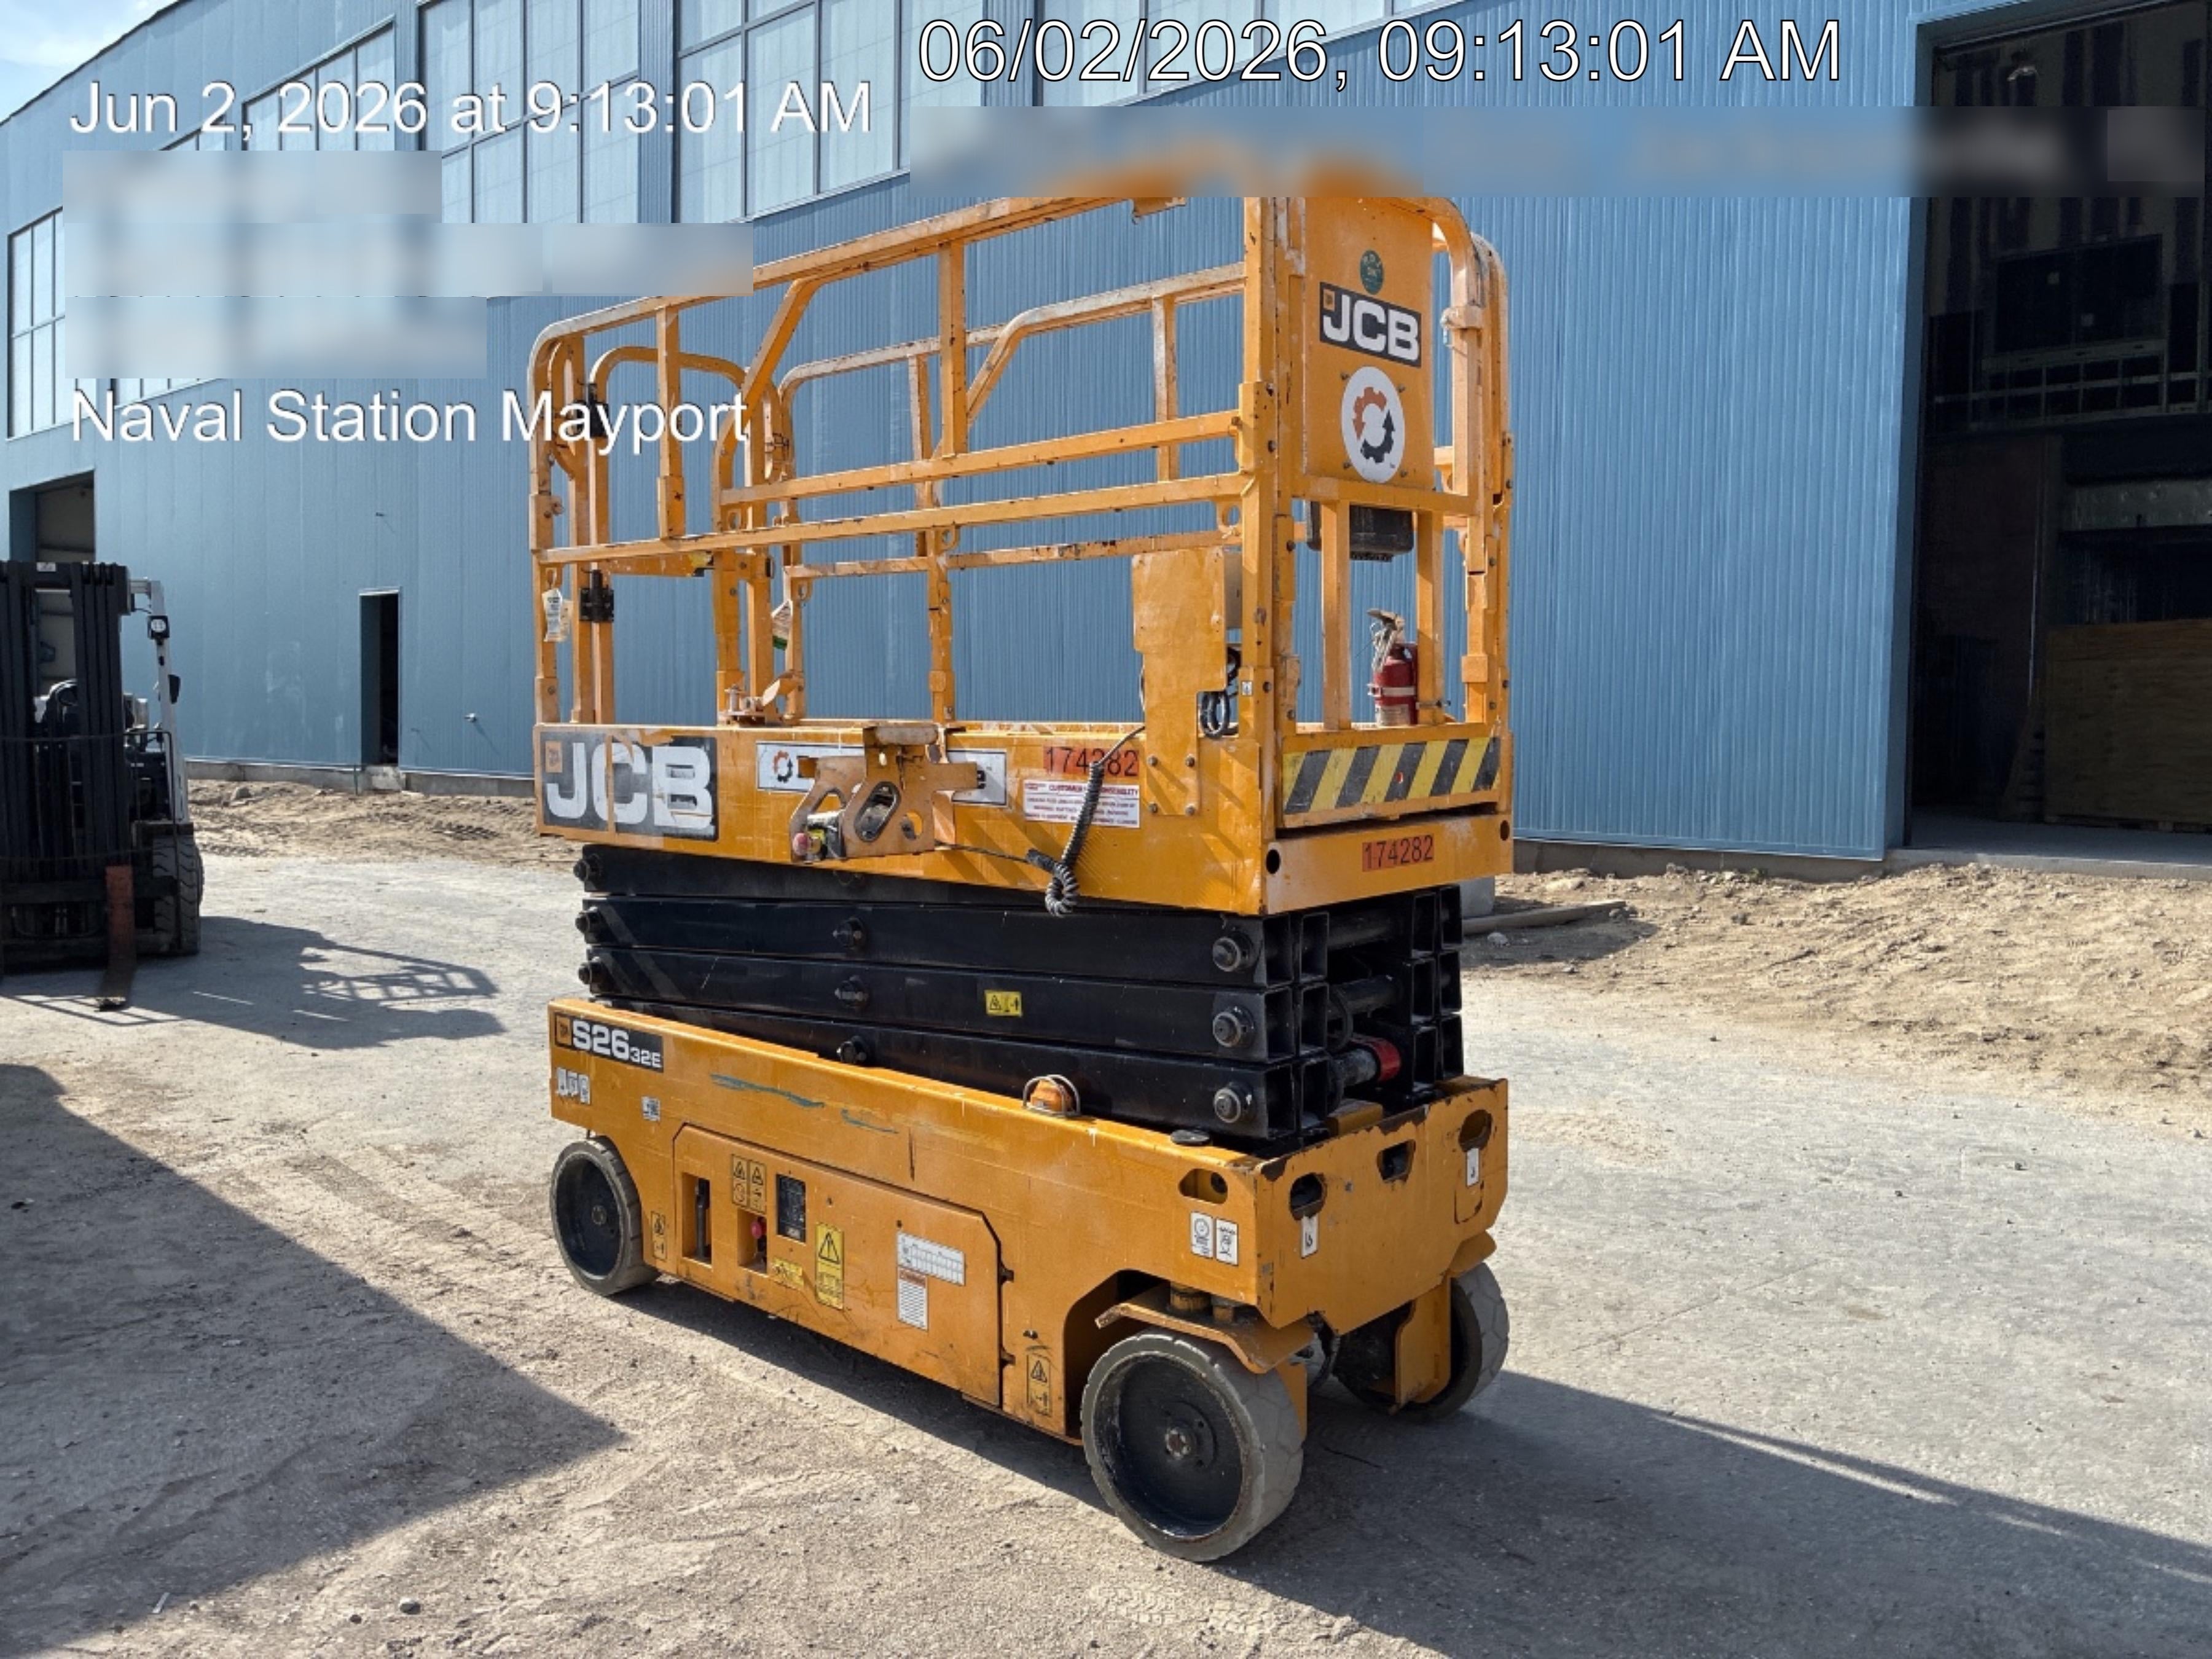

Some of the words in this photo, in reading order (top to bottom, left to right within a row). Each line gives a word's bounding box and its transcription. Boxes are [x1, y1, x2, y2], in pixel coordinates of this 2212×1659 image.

[1323, 292, 1420, 361] JCB
[547, 742, 712, 830] JCB
[1364, 834, 1434, 869] 174282
